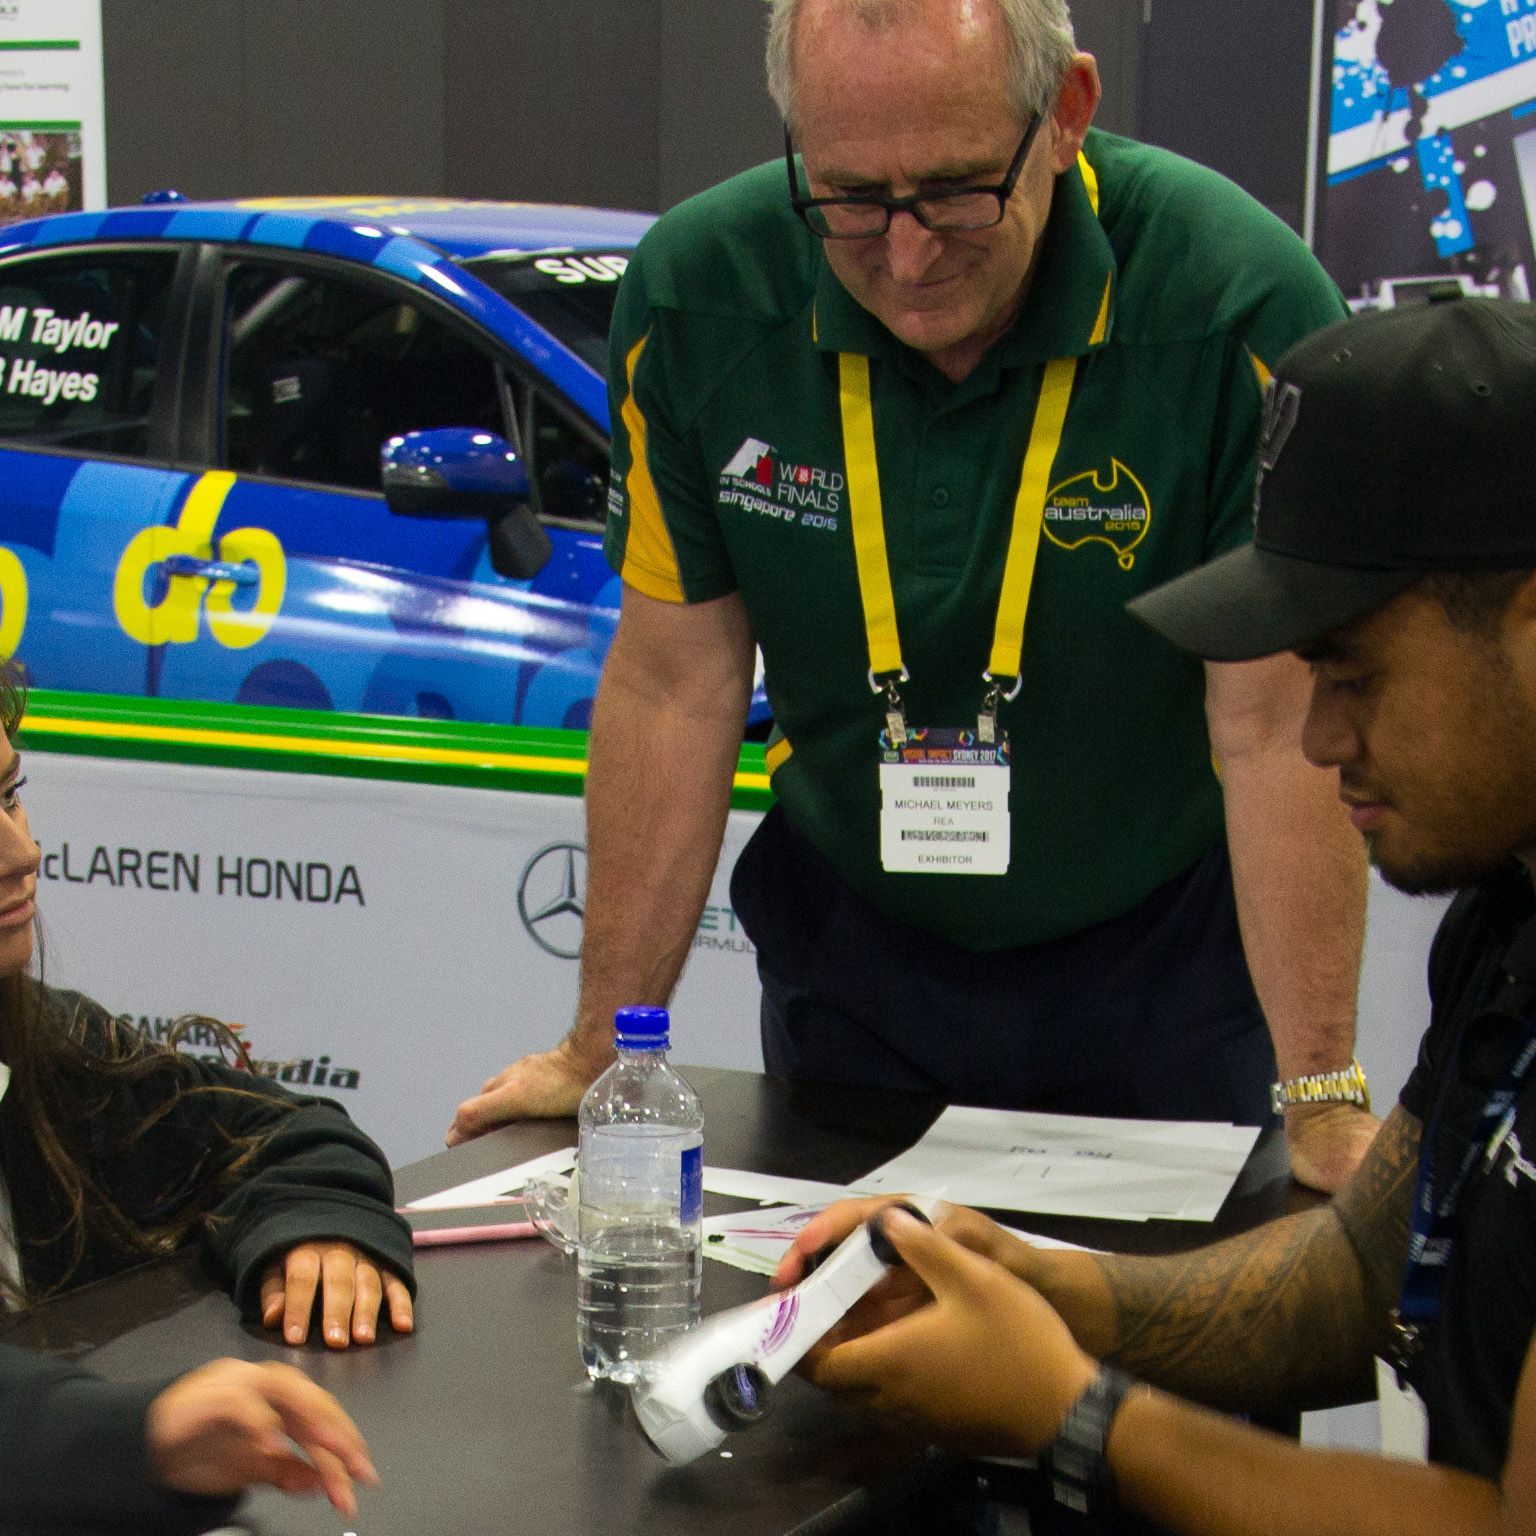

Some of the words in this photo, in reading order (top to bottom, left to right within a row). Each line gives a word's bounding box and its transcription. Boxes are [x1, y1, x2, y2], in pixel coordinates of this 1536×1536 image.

[31, 308, 120, 353] Taylor
[7, 358, 100, 405] Hayes
[719, 488, 796, 521] singapore
[778, 482, 840, 513] FINALS
[1044, 503, 1146, 521] australia
[980, 749, 997, 761] 2017
[895, 799, 944, 811] MICHAEL
[946, 800, 994, 812] MEYERS
[933, 817, 955, 826] REA
[918, 855, 973, 865] EXHIBITOR
[36, 841, 200, 893] cLAREN
[217, 855, 366, 907] HONDA
